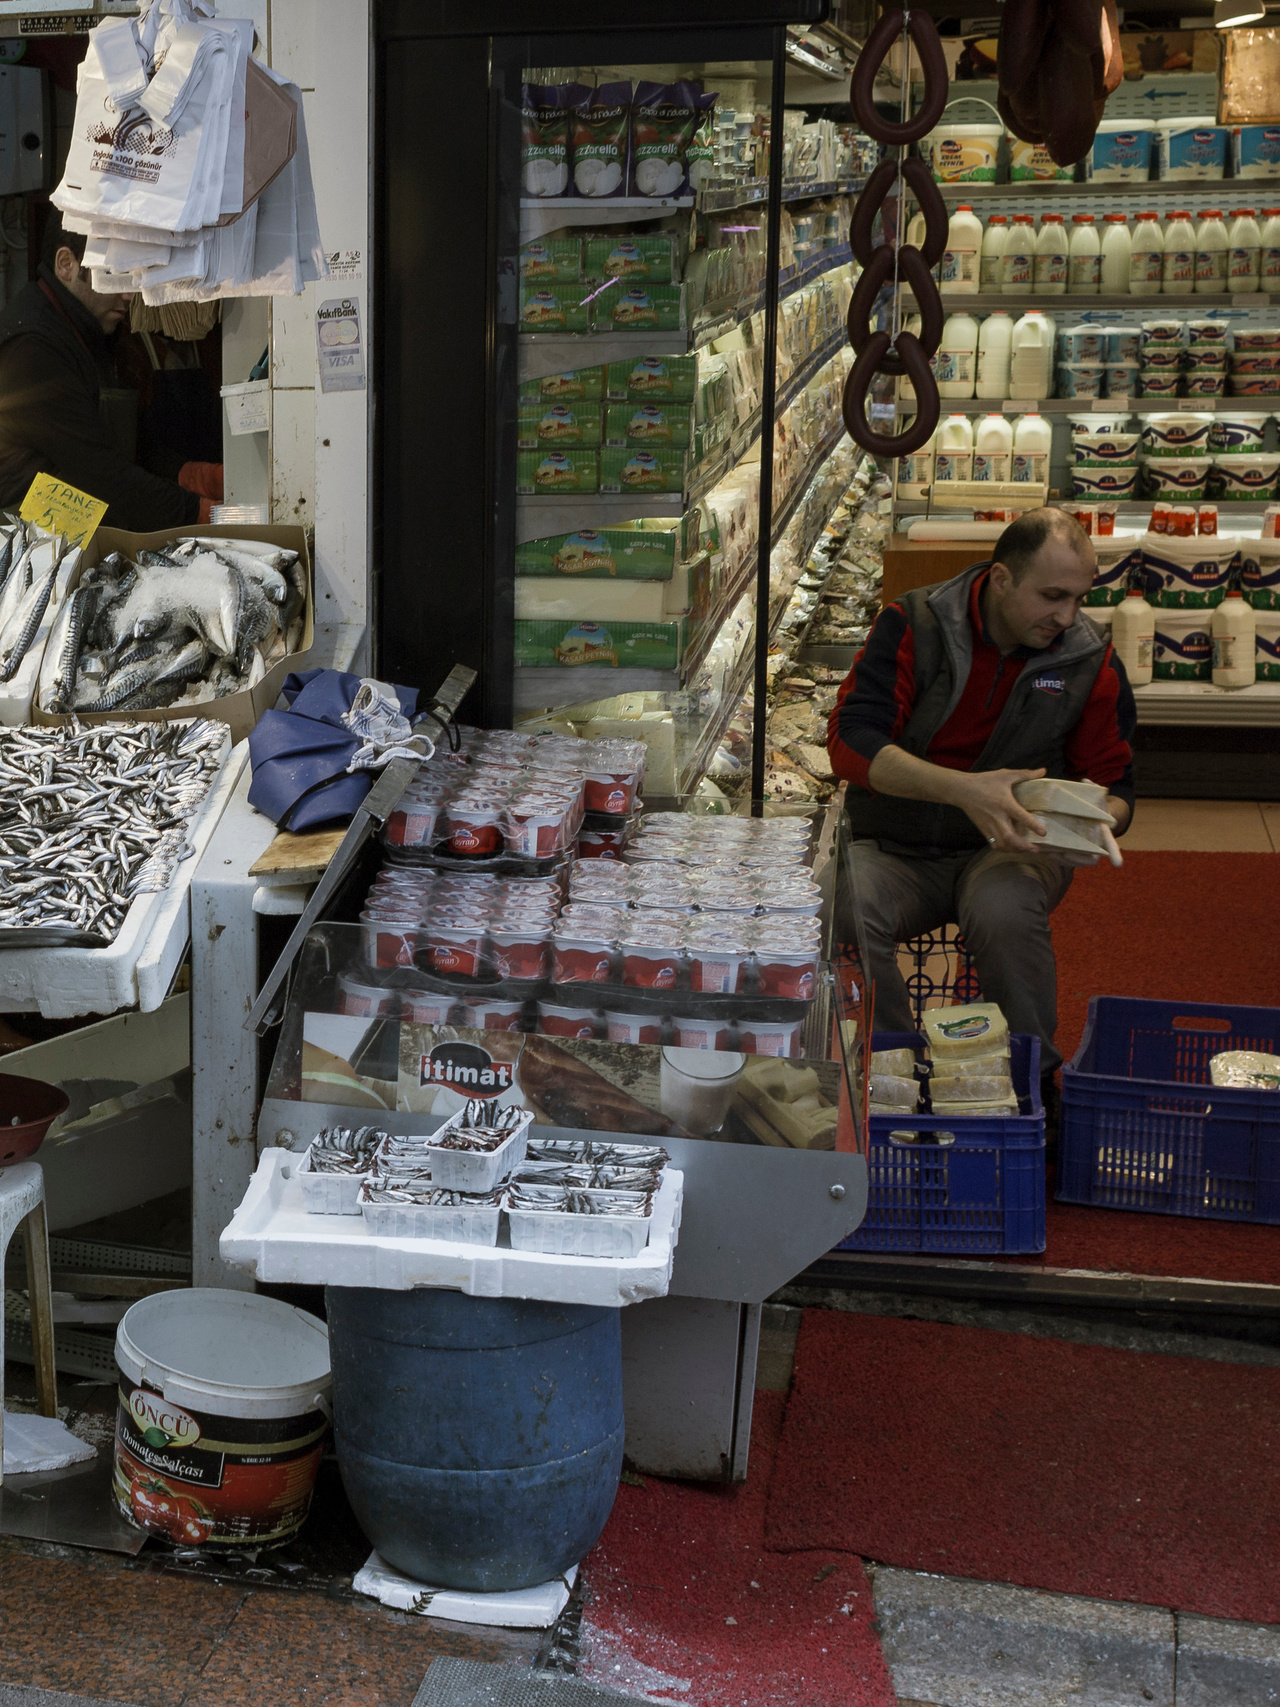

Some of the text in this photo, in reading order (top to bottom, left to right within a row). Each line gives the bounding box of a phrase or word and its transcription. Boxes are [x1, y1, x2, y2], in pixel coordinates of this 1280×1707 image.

[93, 150, 114, 160] Doğada
[135, 159, 162, 171] çözünür
[317, 306, 358, 320] VakıfBank
[328, 355, 355, 368] VISA
[46, 483, 102, 511] TANE
[453, 836, 476, 848] ayran
[434, 957, 455, 967] ayran
[423, 1057, 510, 1087] itimat
[134, 1395, 193, 1437] ÖNCÜ
[122, 1426, 205, 1479] Domates Salçası
